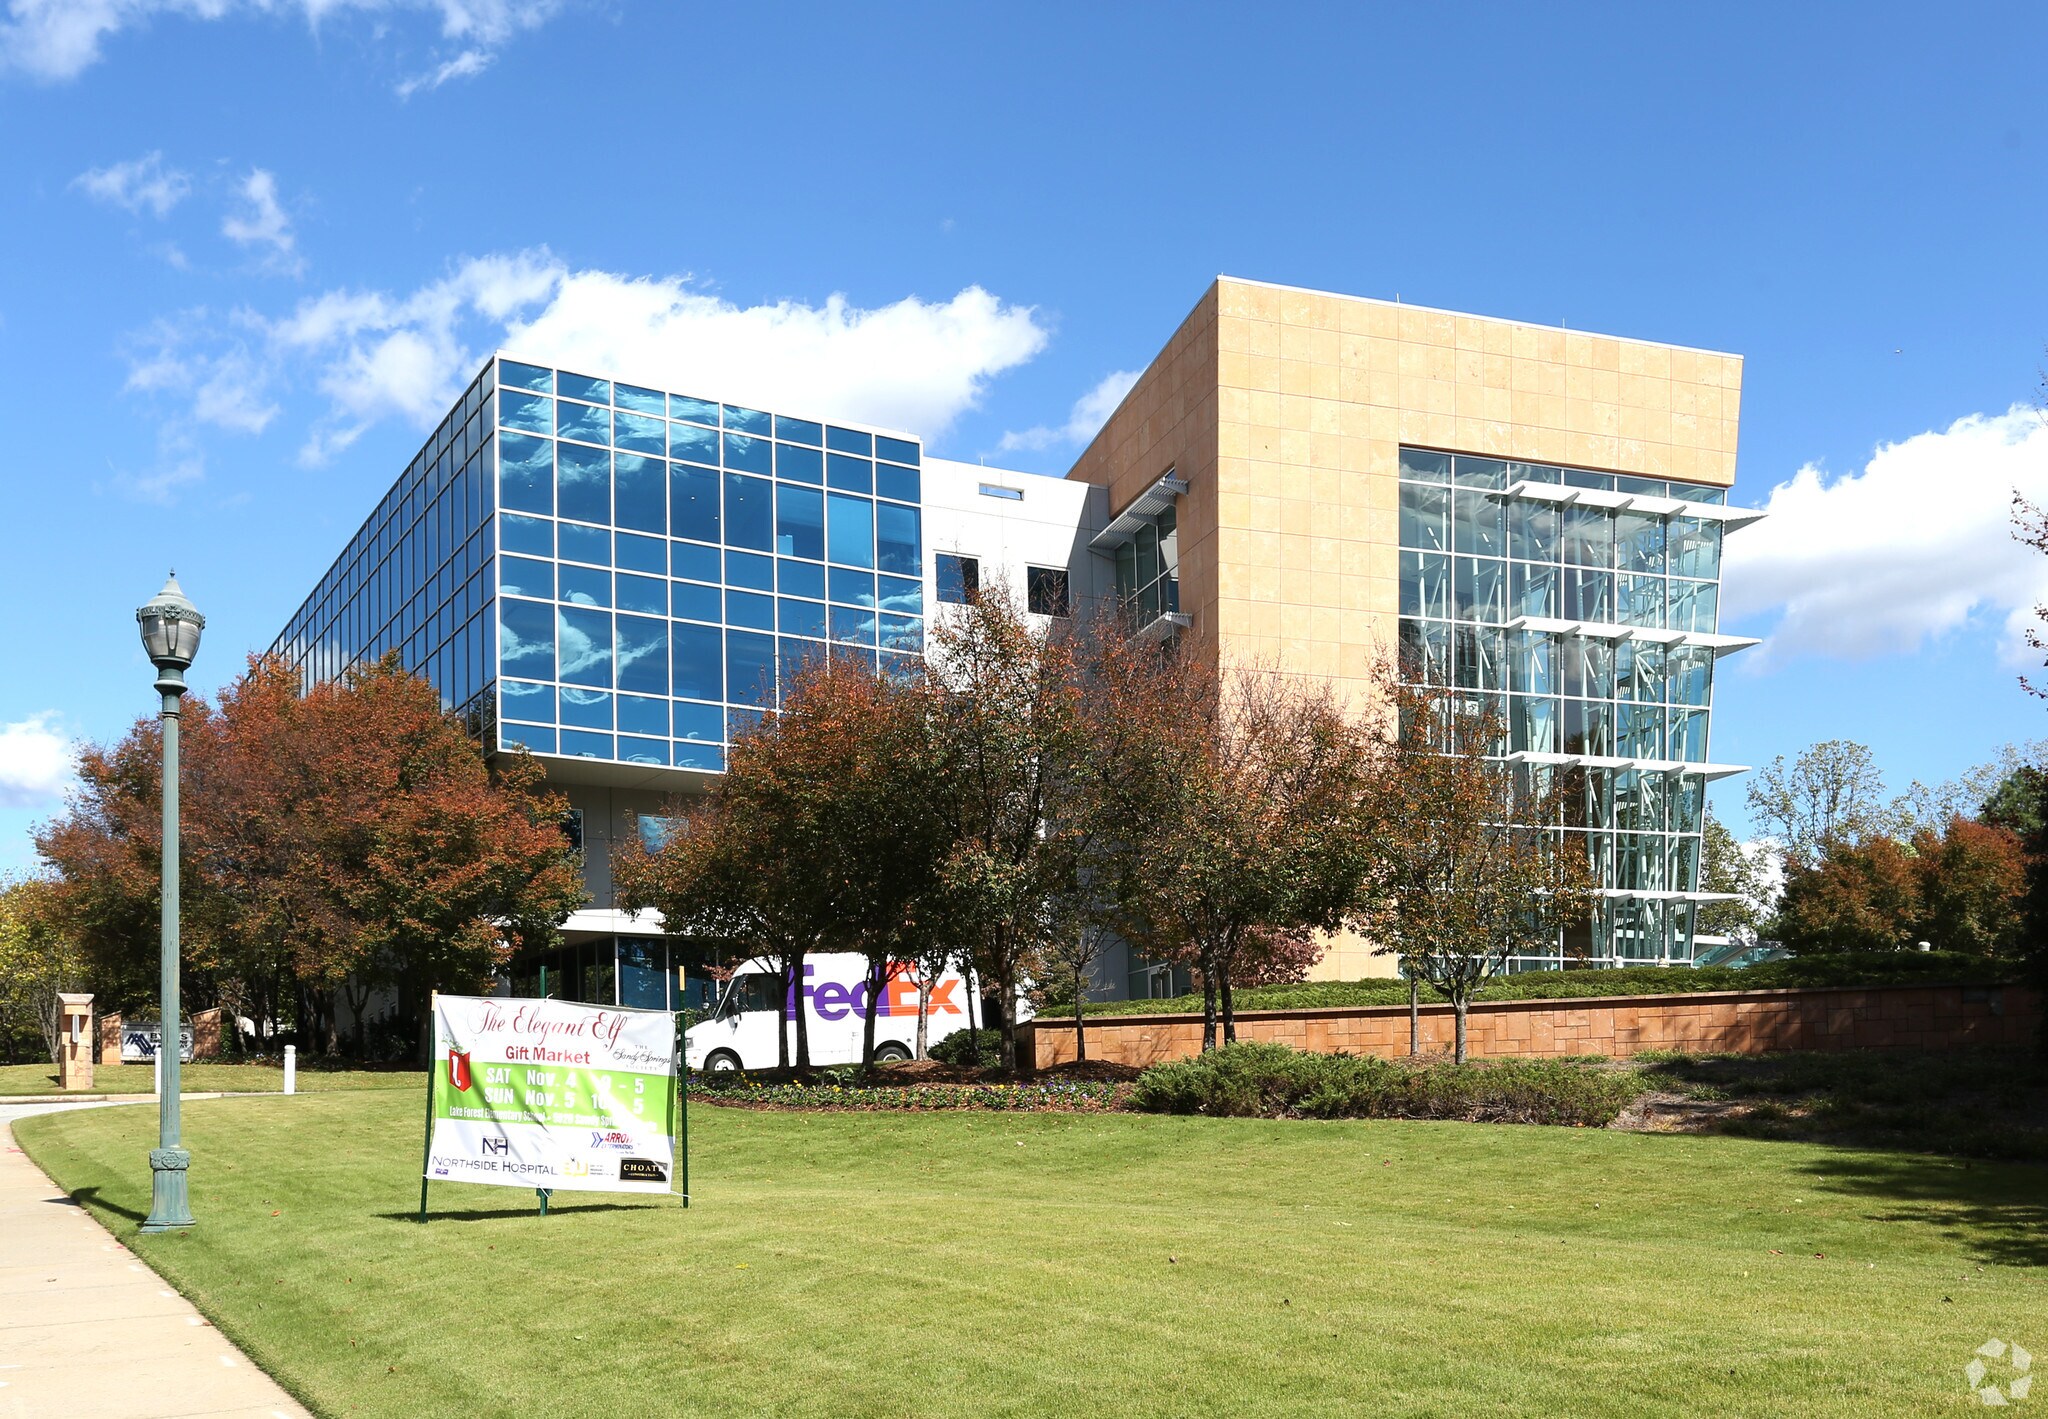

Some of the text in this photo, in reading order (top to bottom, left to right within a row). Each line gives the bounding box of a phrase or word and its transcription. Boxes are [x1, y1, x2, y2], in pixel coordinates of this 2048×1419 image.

[785, 959, 962, 1021] FedEx
[467, 999, 629, 1052] The Elegant Elf
[505, 1045, 591, 1065] Gift Market
[612, 1048, 671, 1068] Sandy Springs
[485, 1067, 512, 1084] SAT
[565, 1072, 577, 1088] 4
[633, 1077, 645, 1094] 5
[484, 1086, 514, 1104] SUN
[564, 1091, 577, 1108] 5
[632, 1098, 645, 1115] 5
[449, 1106, 463, 1117] Lake
[464, 1107, 484, 1119] Forest
[485, 1108, 523, 1122] Elementary
[432, 1156, 498, 1171] NORTHSIDE
[502, 1161, 558, 1176] HOSPITAL
